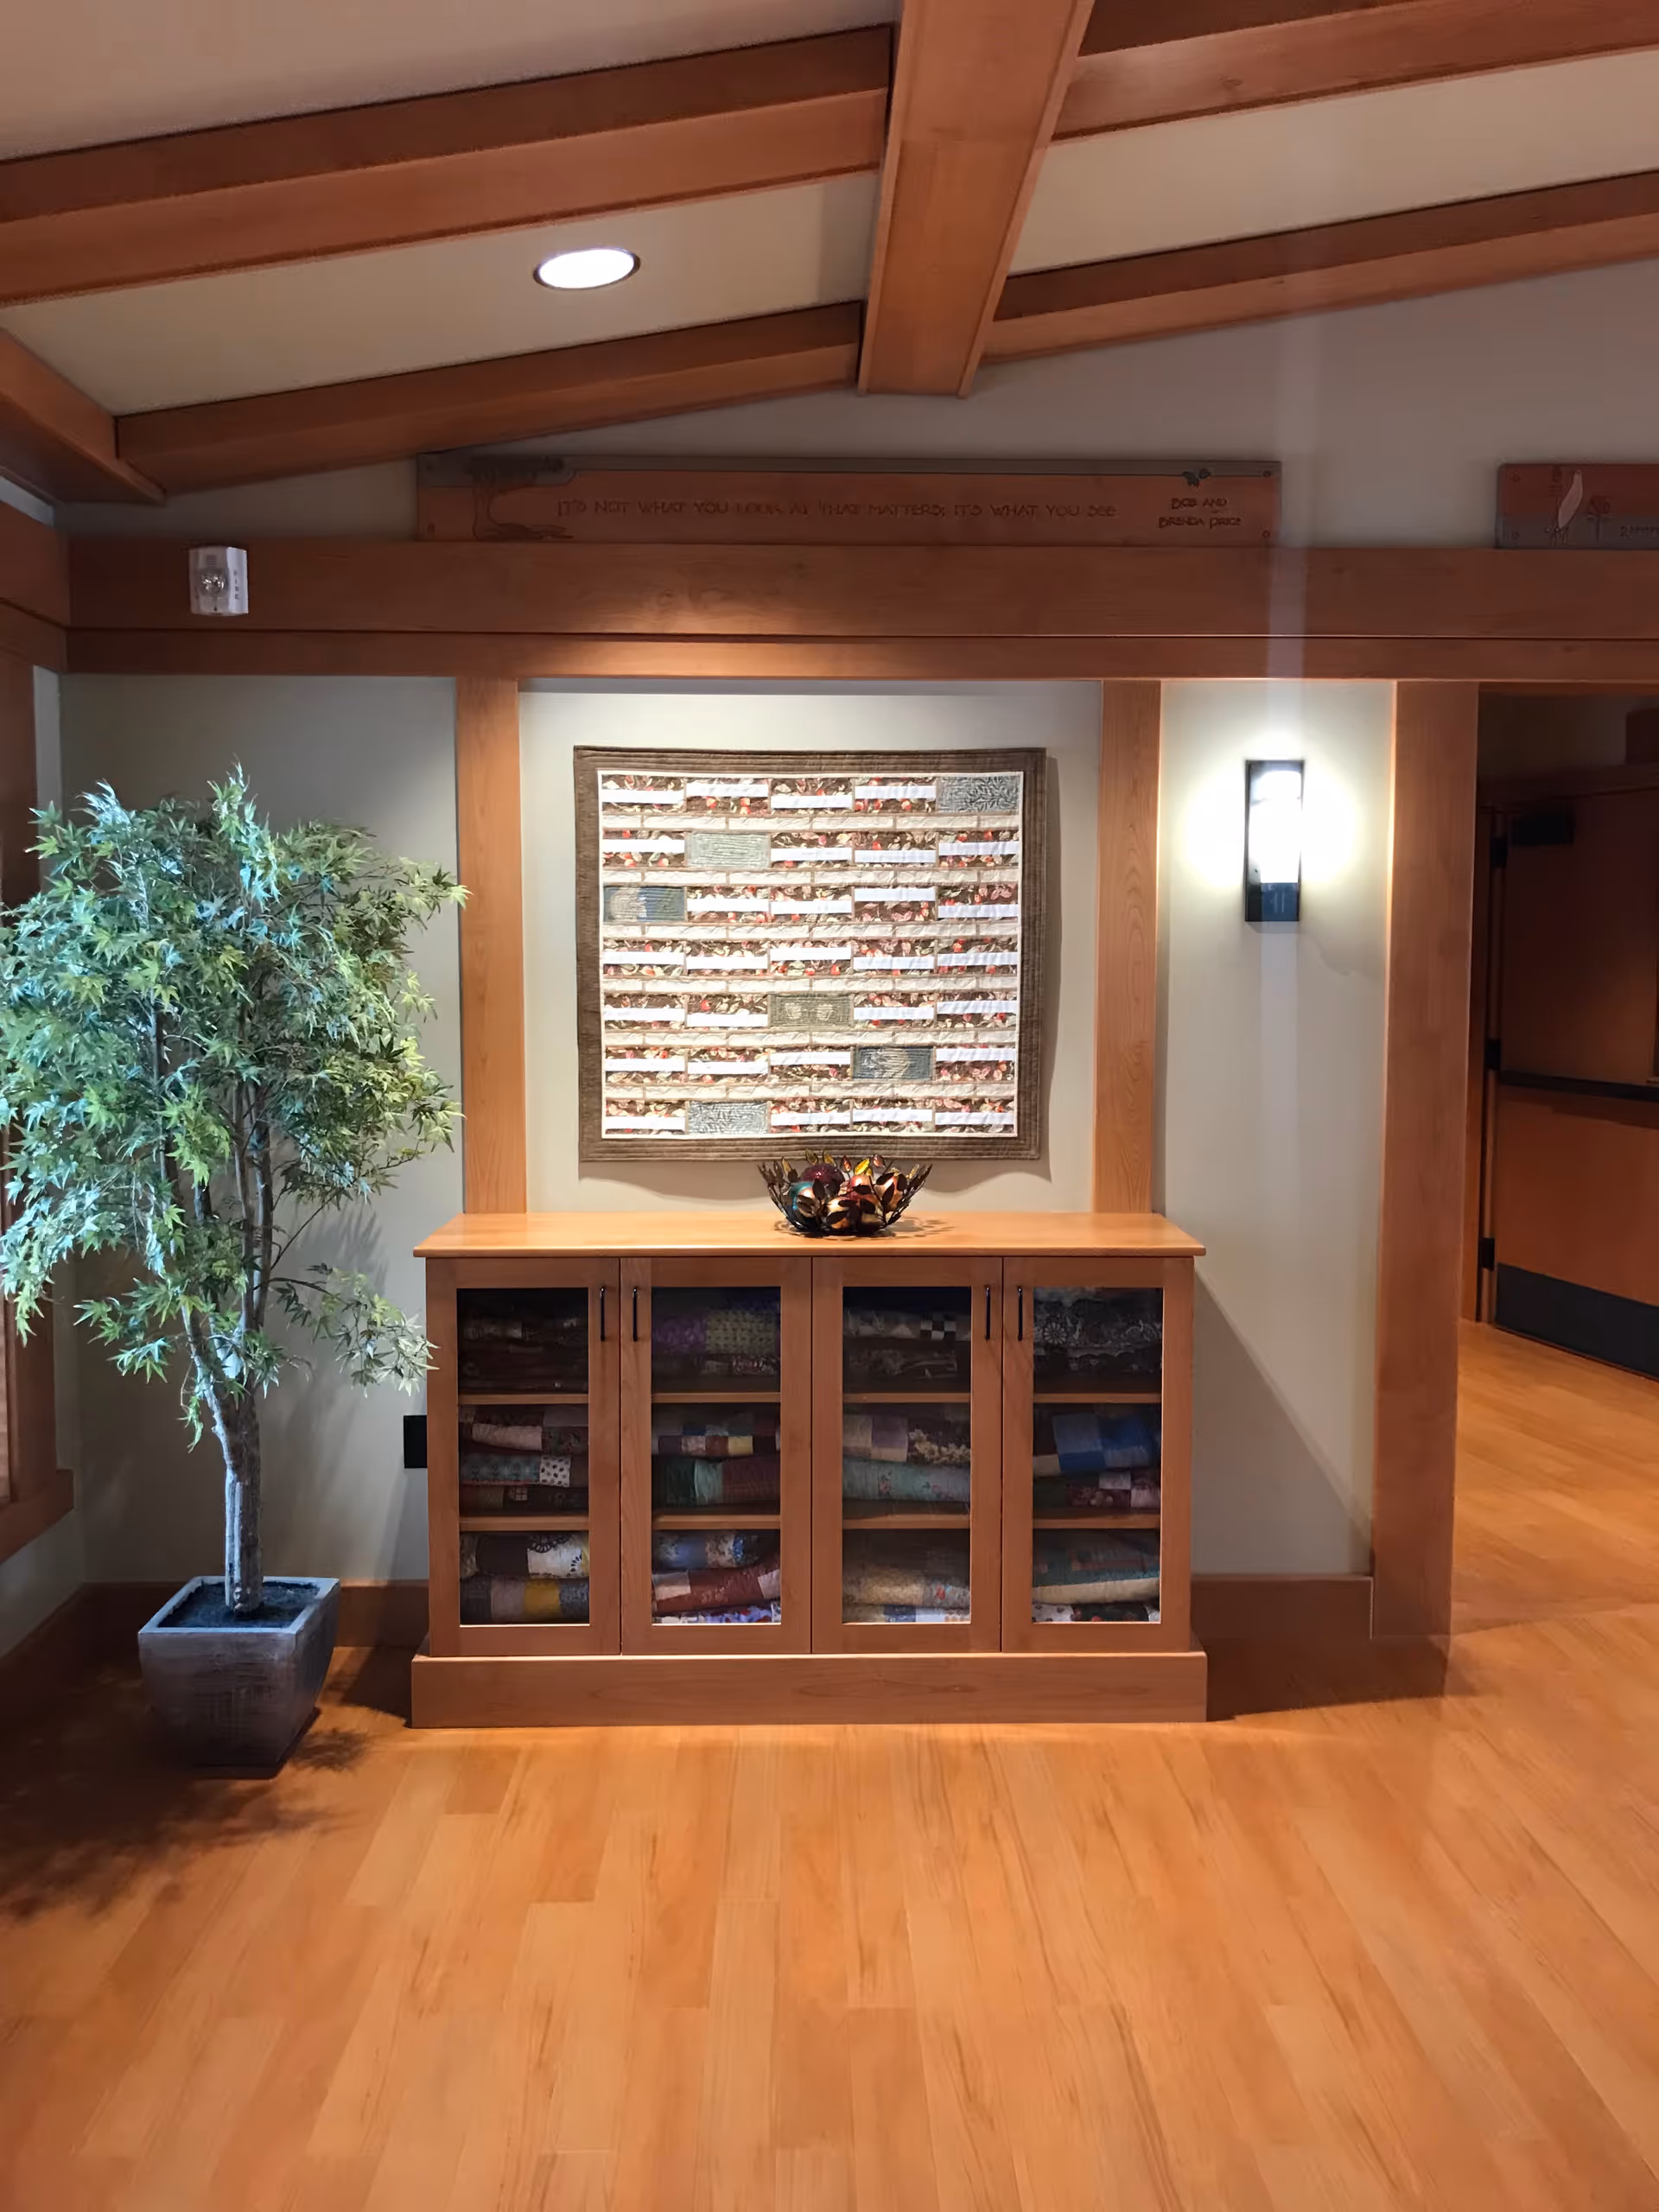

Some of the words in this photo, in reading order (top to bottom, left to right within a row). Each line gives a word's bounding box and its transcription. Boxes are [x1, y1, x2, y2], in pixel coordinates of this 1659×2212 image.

[594, 500, 630, 516] NOT
[638, 499, 687, 515] WHAT
[694, 500, 729, 514] YOU
[817, 502, 861, 516] THAT
[989, 504, 1038, 518] WHAT
[1046, 504, 1080, 518] YOU
[1087, 505, 1117, 518] SEE
[1203, 498, 1227, 507] AND
